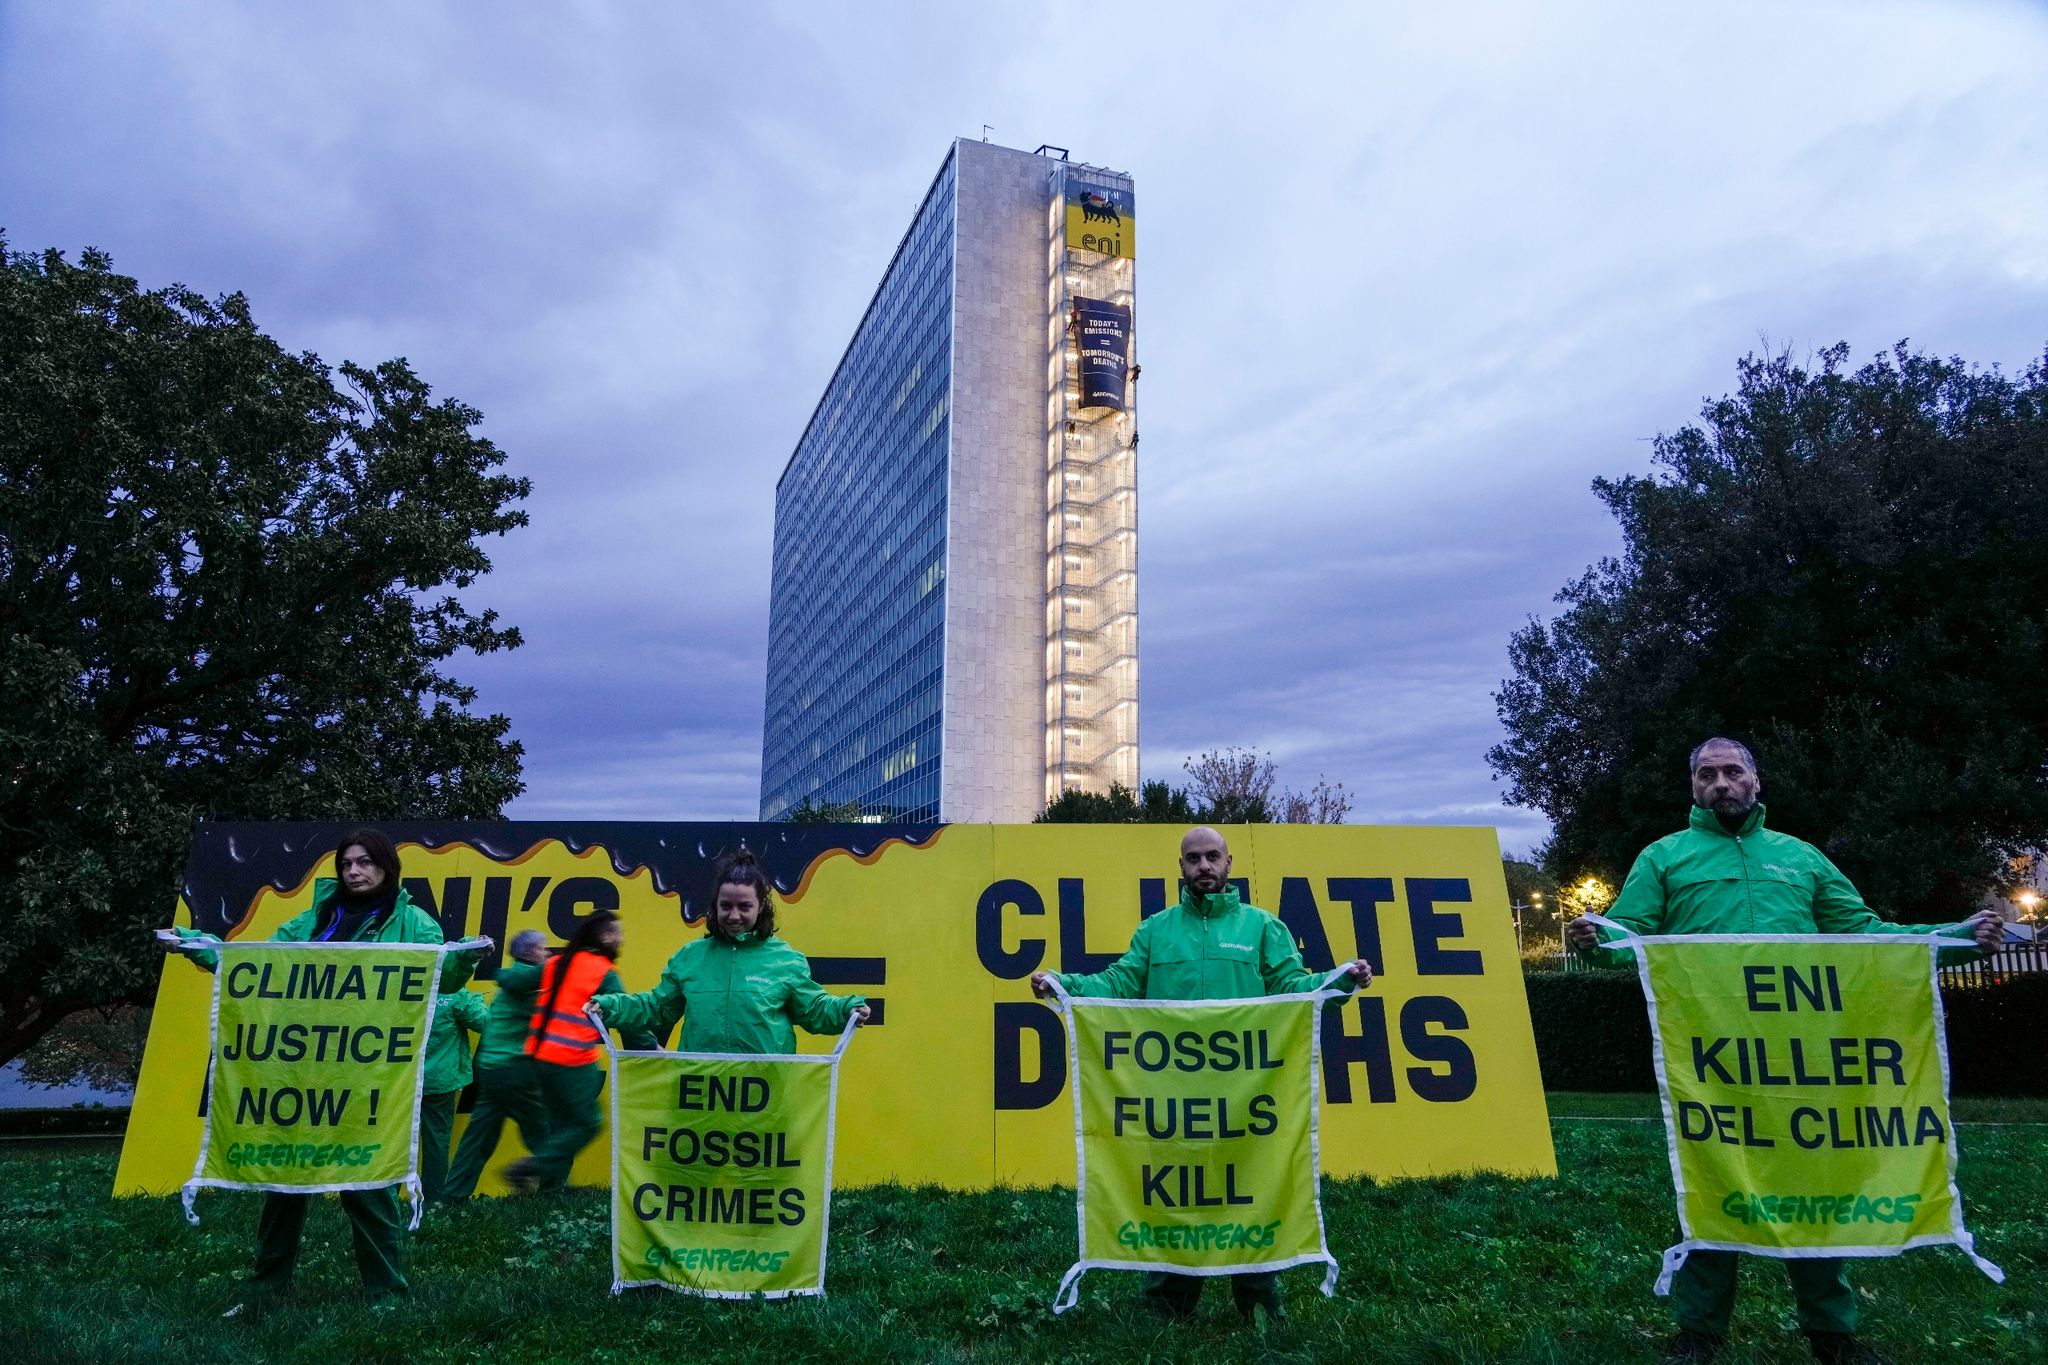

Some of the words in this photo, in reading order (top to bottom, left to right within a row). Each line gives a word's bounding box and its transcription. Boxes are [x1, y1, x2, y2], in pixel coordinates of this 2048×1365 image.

[1082, 233, 1120, 256] eni
[1084, 328, 1123, 338] EMISSIONS
[1089, 319, 1119, 328] TODAY'S
[1081, 349, 1125, 365] TOMORROW'S
[1093, 357, 1117, 370] DEATHS
[228, 962, 427, 1002] CLIMATE
[1742, 965, 1844, 1013] ENI
[223, 1023, 414, 1063] JUSTICE
[994, 995, 1478, 1111] DHS
[1104, 1029, 1285, 1072] FOSSIL
[1691, 1037, 1907, 1087] KILLER
[235, 1087, 352, 1127] NOW
[678, 1074, 770, 1113] END
[1113, 1094, 1278, 1139] FUELS
[1677, 1100, 1777, 1148] DEL
[1790, 1106, 1946, 1150] CLIMA
[226, 1143, 381, 1169] GREENPEACE
[642, 1127, 801, 1168] FOSSIL
[633, 1183, 806, 1227] CRIMES
[1141, 1163, 1254, 1208] KILL
[1720, 1190, 1922, 1227] GREENPEACE
[1117, 1219, 1282, 1251] GREENPEACE
[645, 1245, 790, 1273] GREENPEACE
